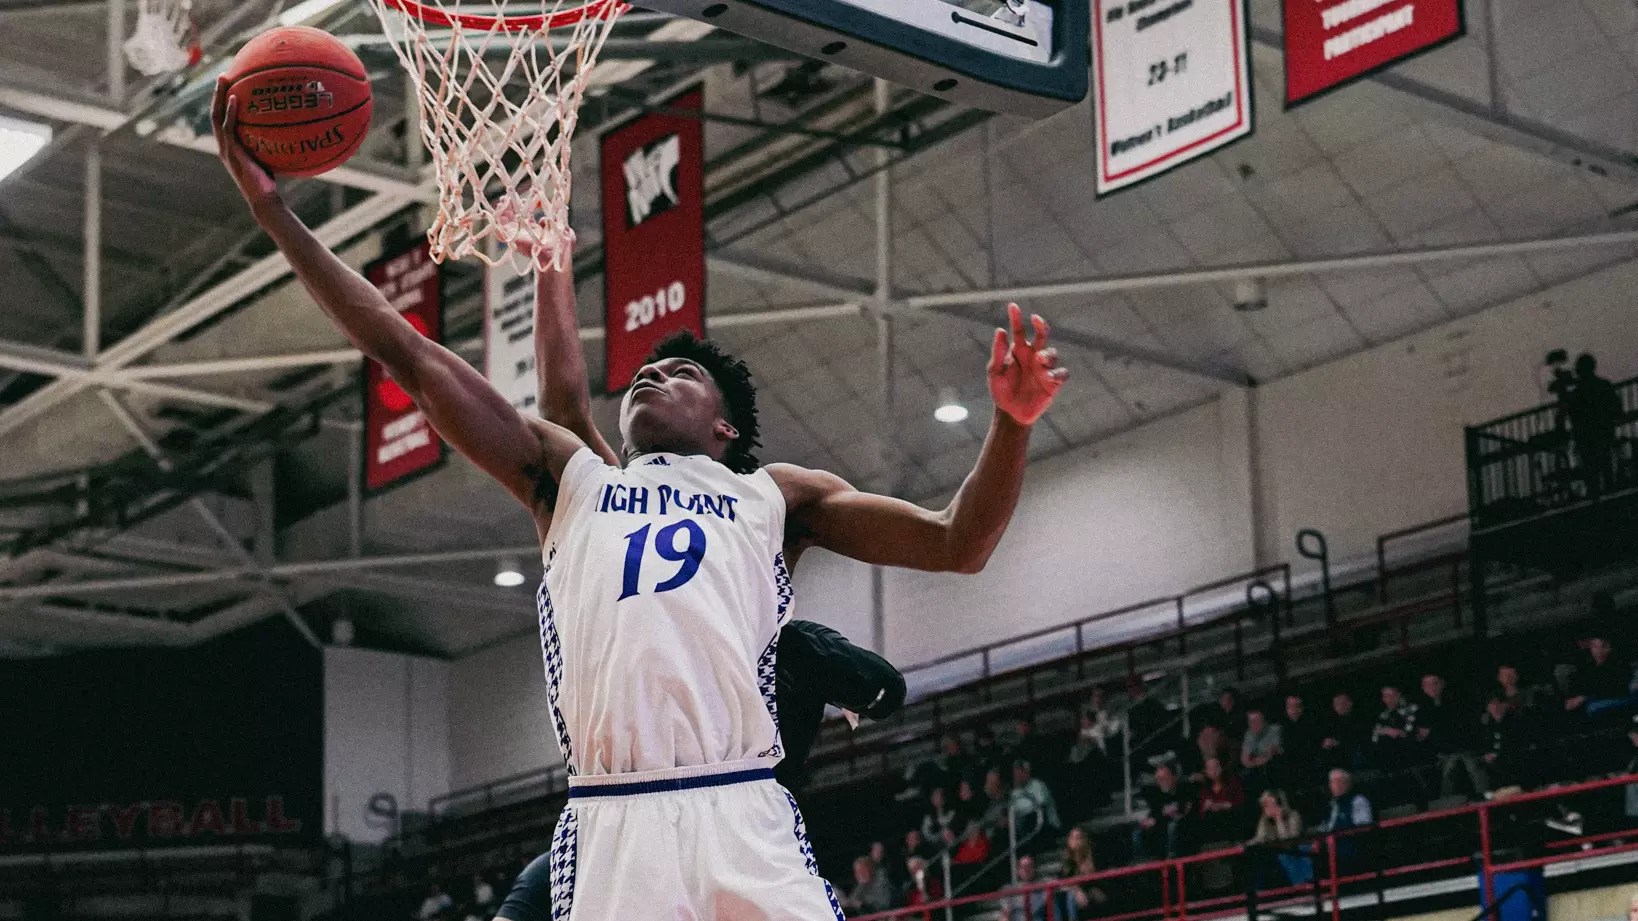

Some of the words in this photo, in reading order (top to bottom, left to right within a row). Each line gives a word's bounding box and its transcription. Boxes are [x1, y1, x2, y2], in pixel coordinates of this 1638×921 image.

[248, 92, 333, 114] LEGACY
[625, 281, 685, 332] 2010
[595, 484, 649, 514] IGH
[657, 484, 738, 522] POINT
[616, 518, 707, 602] 19
